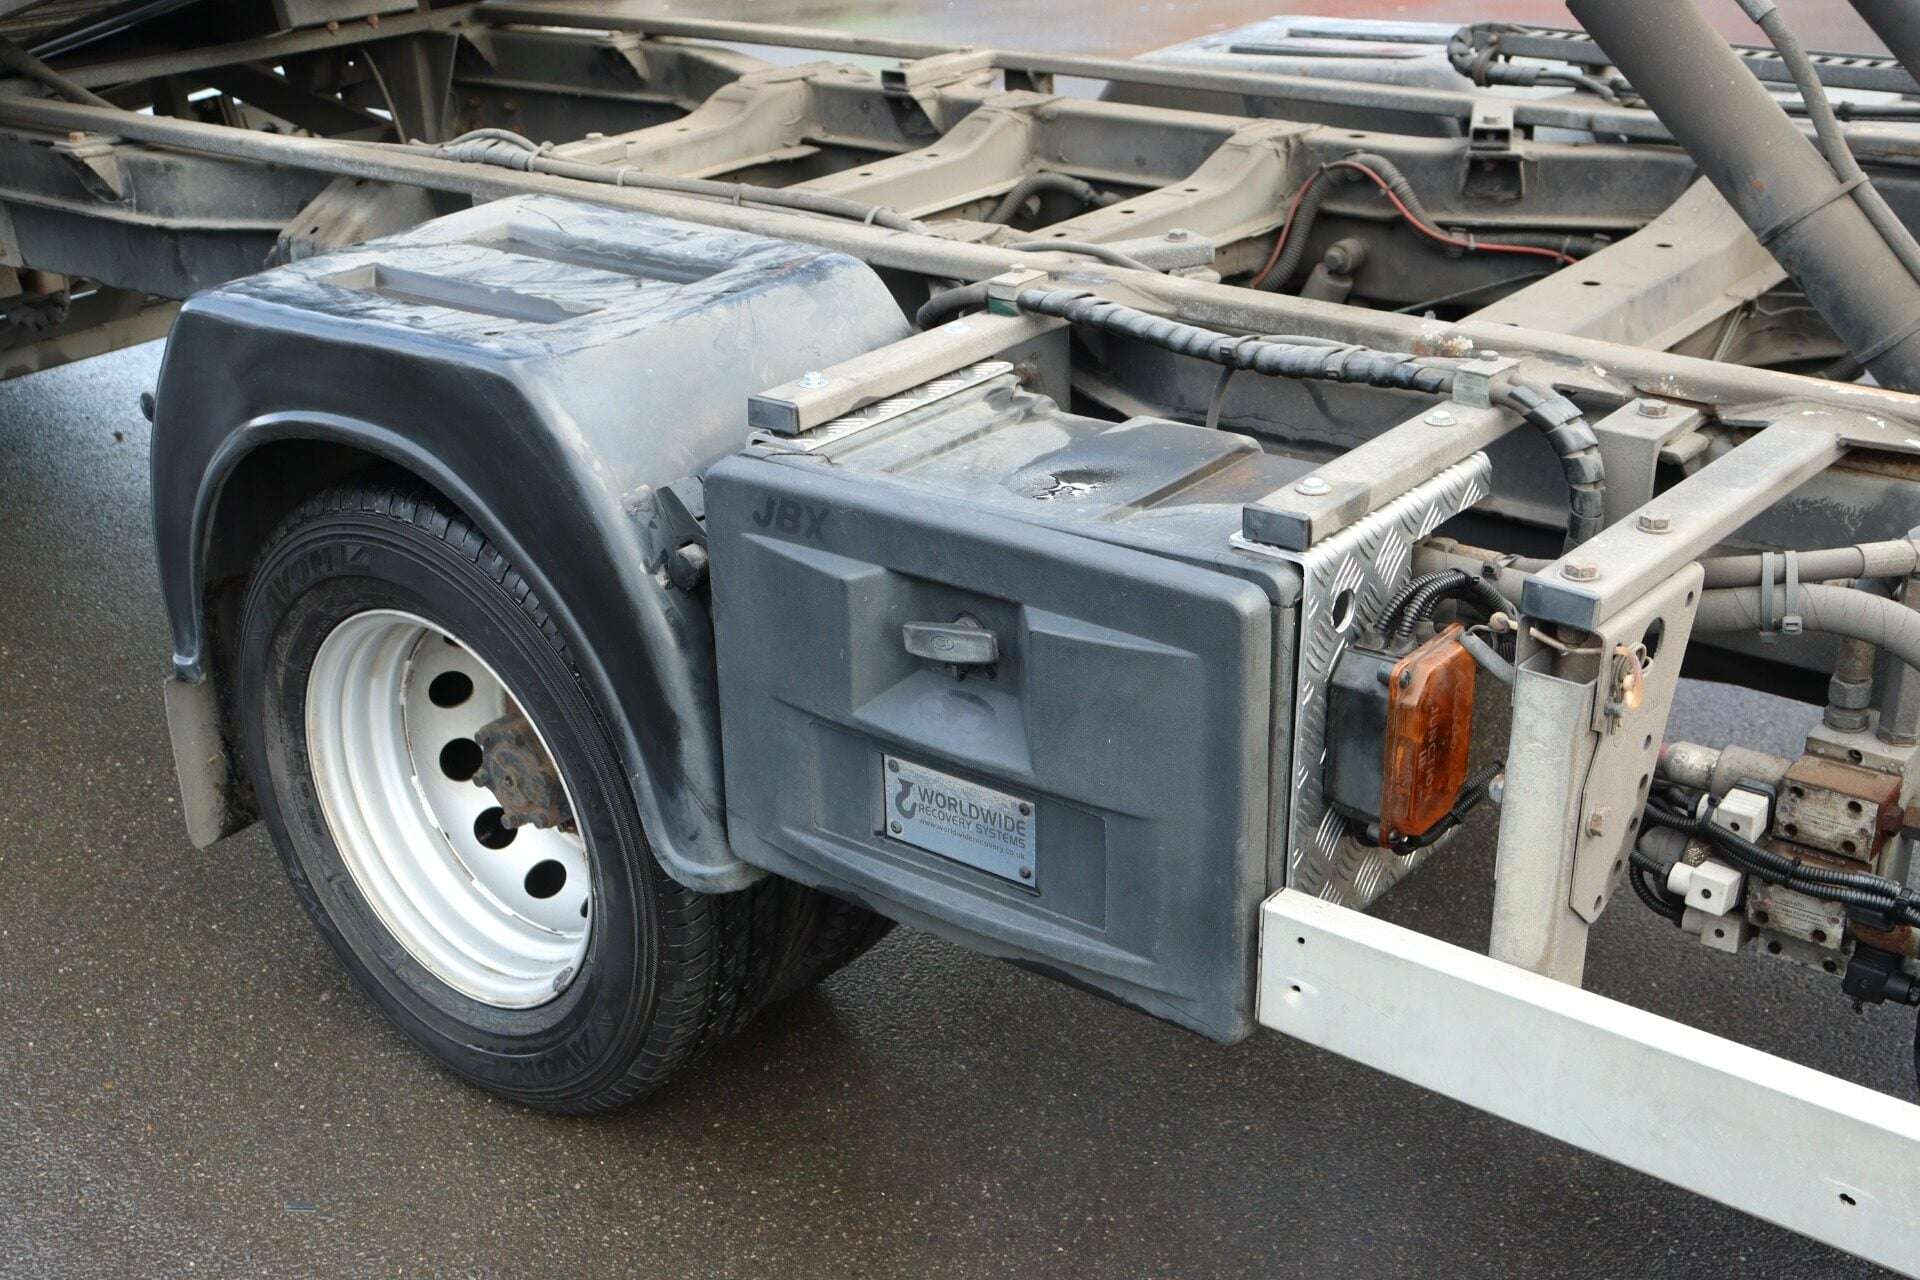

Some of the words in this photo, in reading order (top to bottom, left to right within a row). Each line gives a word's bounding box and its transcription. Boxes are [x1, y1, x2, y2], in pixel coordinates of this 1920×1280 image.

[752, 496, 830, 540] JBX
[918, 785, 1026, 837] WORLDWIDE
[918, 805, 972, 830] RECOVERY
[975, 823, 1026, 849] SYSTEMS
